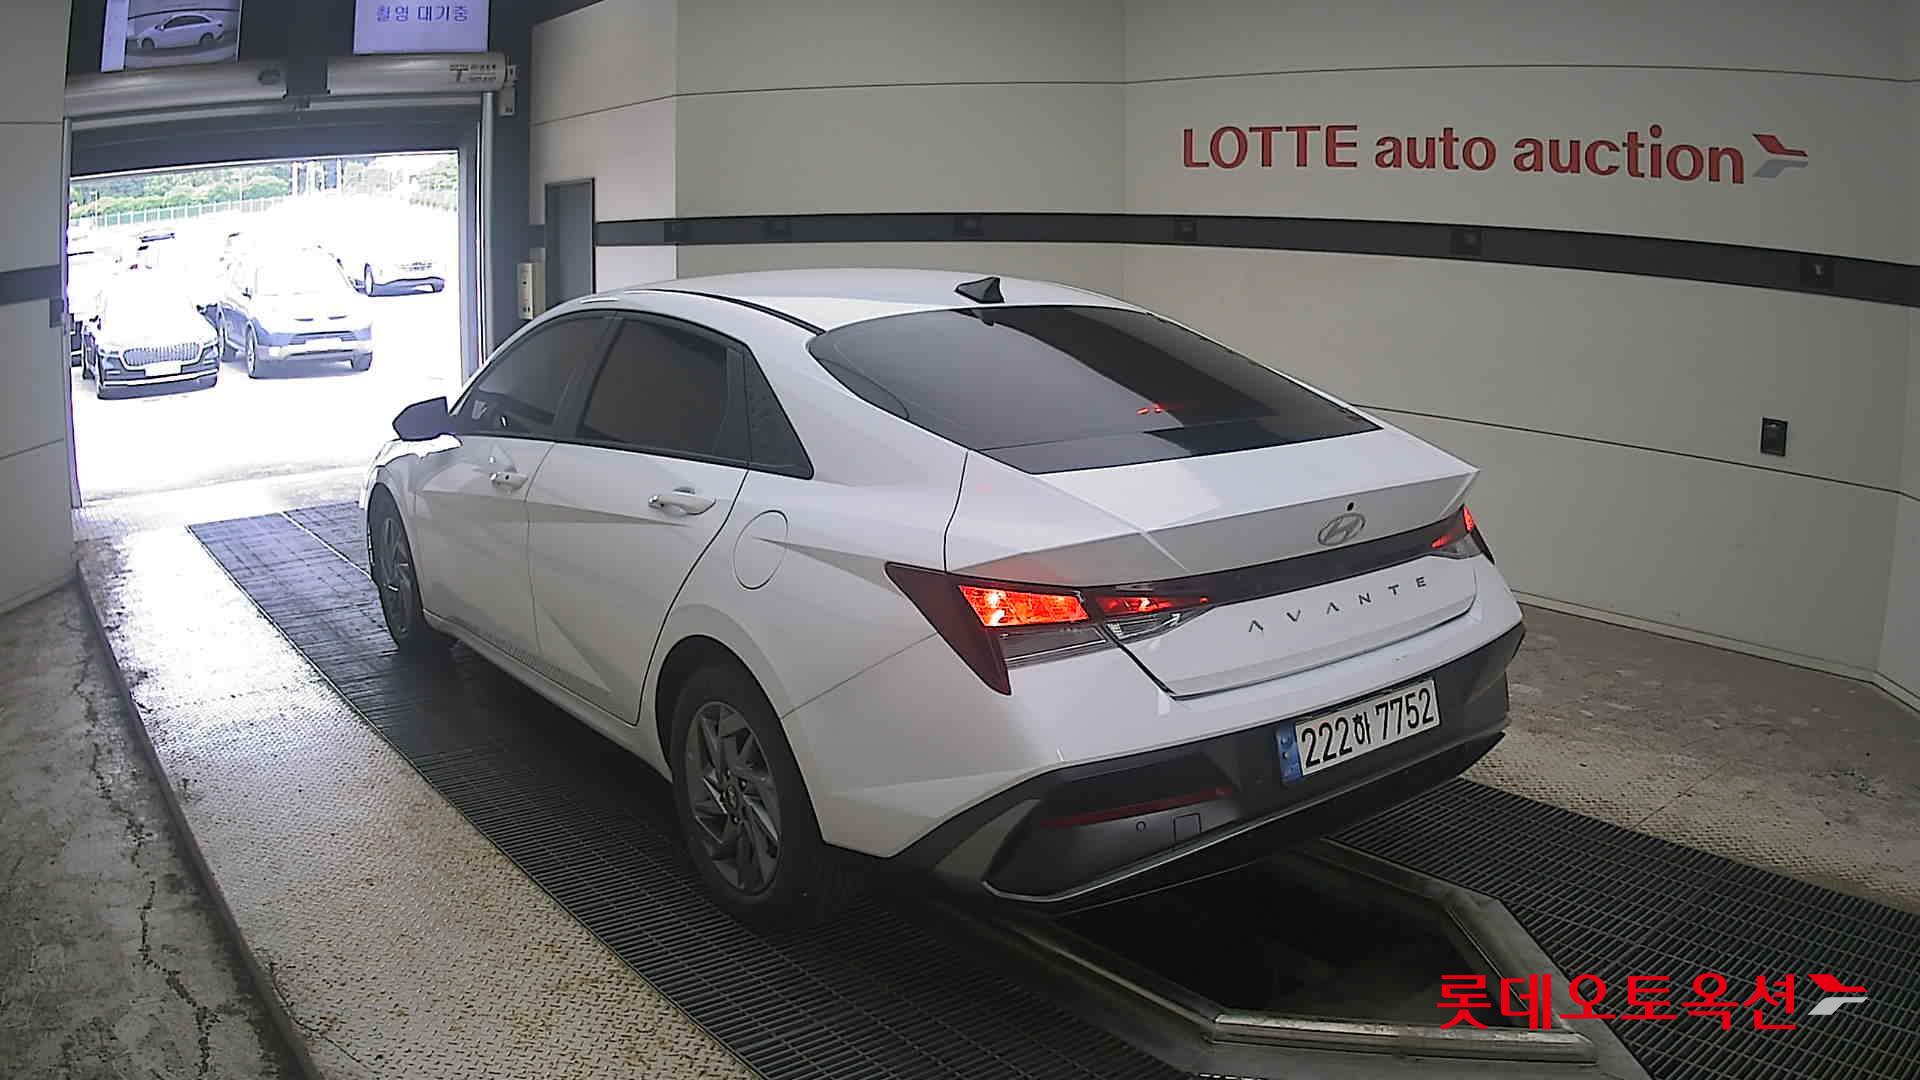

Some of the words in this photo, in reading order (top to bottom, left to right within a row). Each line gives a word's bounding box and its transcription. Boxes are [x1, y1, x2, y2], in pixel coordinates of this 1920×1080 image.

[416, 5, 468, 22] 대기중
[1183, 125, 1358, 169] LOTTE
[1374, 127, 1497, 171] auto
[1512, 124, 1745, 185] auction
[1248, 576, 1427, 633] AVANTE
[1301, 710, 1372, 768] 222하
[1375, 687, 1435, 741] 7752
